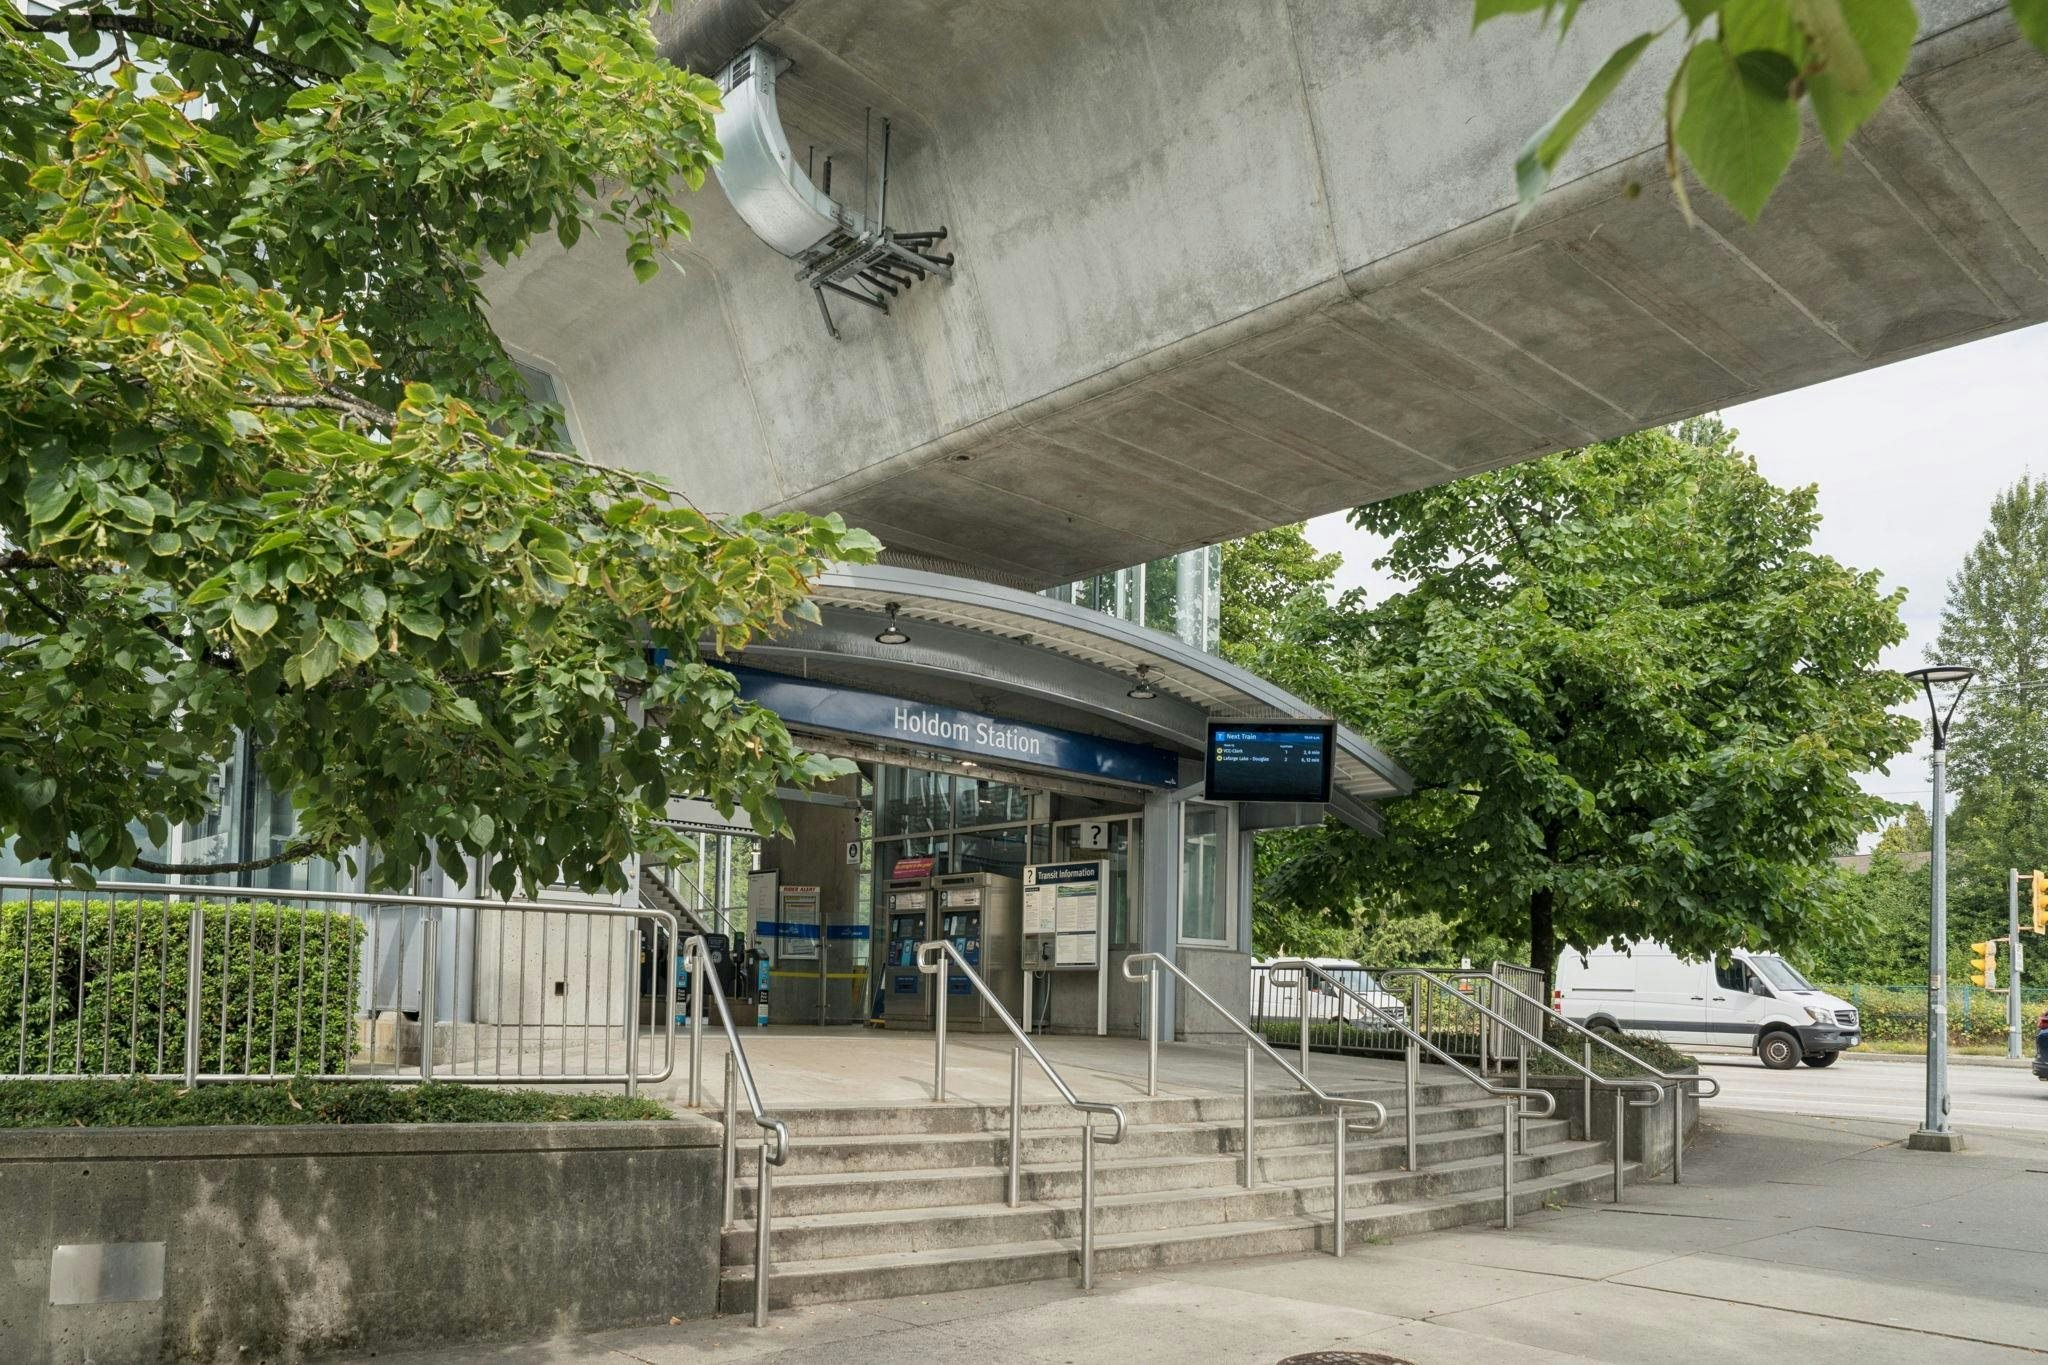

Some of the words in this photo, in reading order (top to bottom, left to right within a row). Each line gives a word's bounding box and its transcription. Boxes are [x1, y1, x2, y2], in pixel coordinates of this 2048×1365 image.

[894, 706, 969, 742] Holdom
[976, 722, 1040, 755] Station
[1038, 869, 1058, 880] Transit
[1059, 867, 1095, 878] Information
